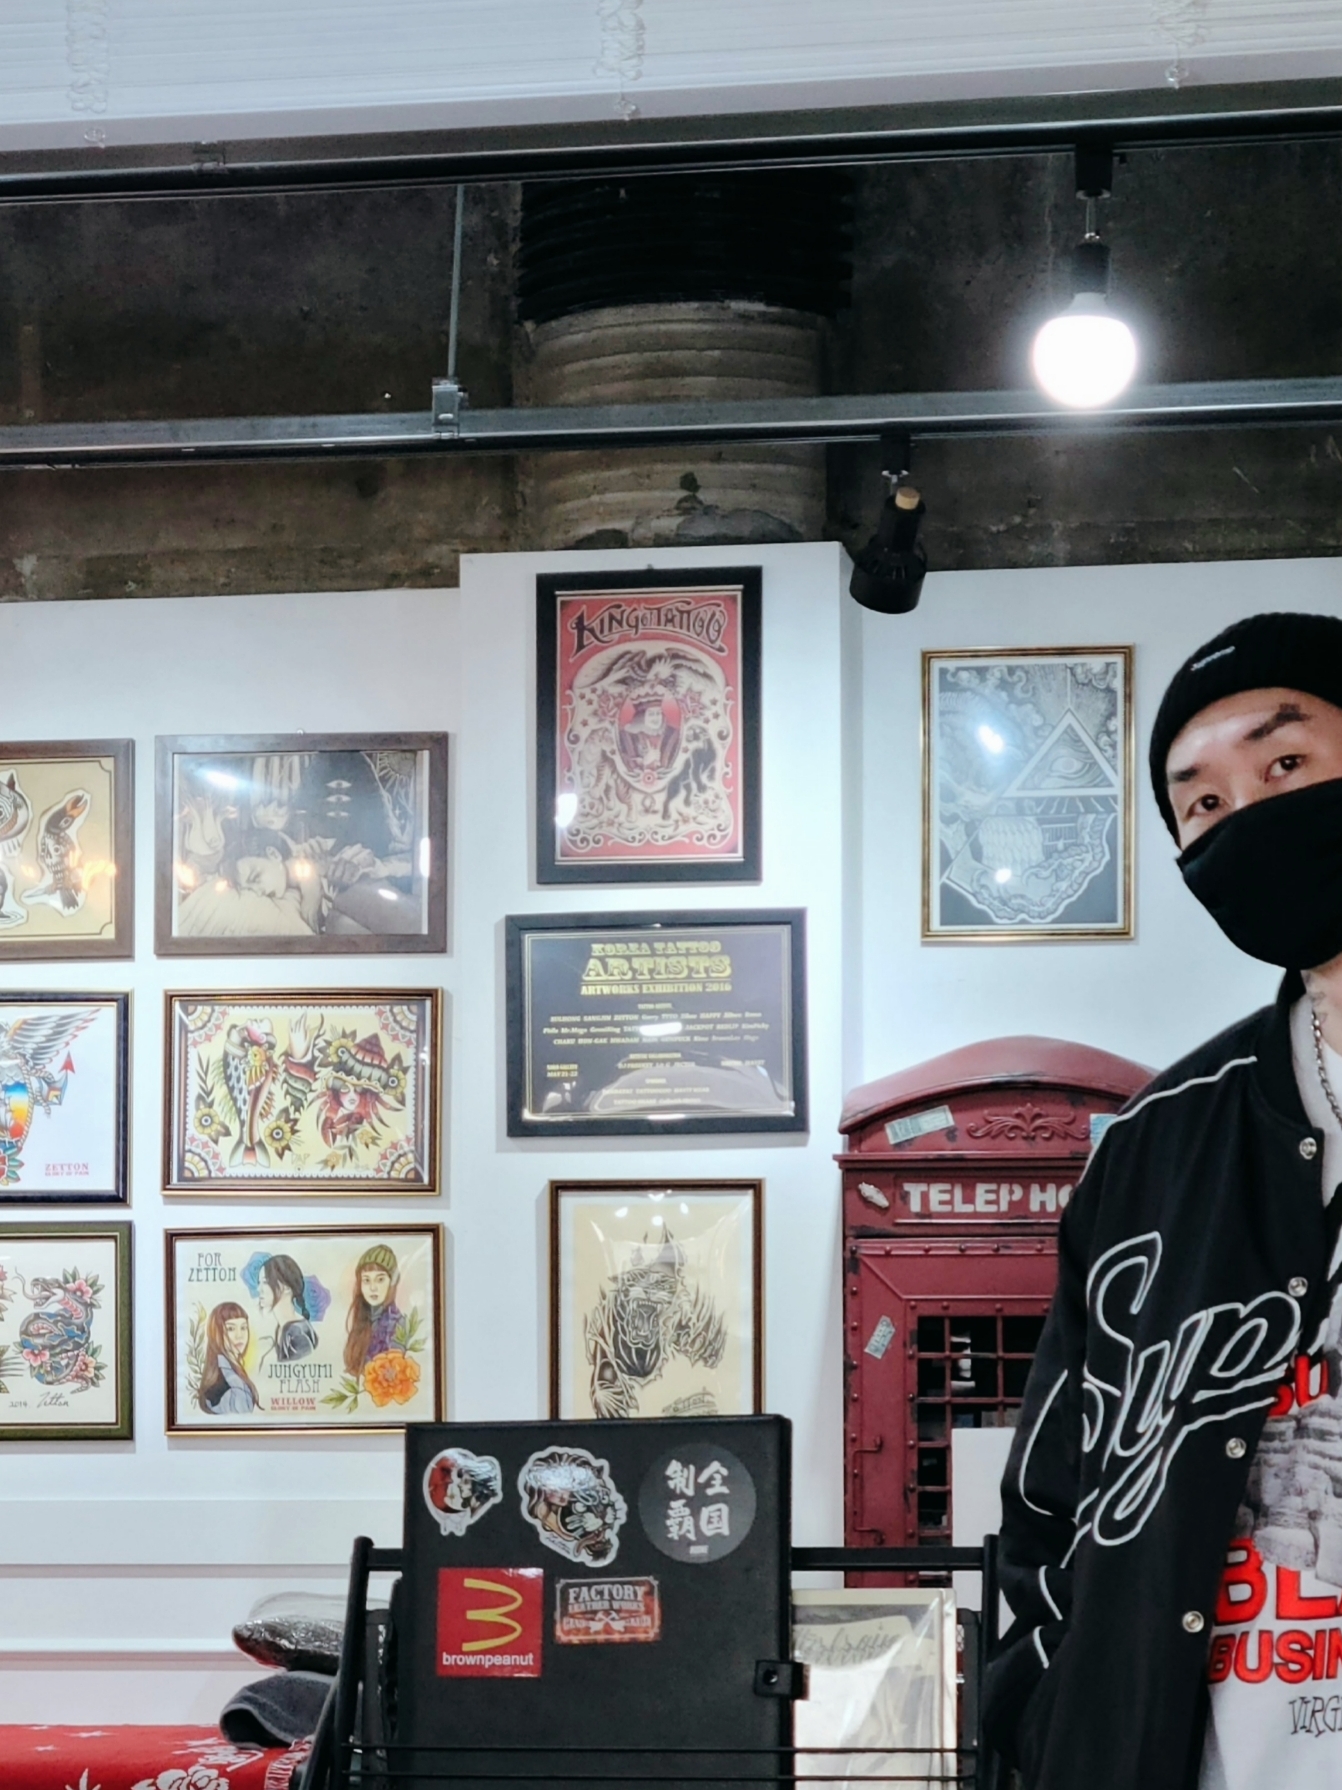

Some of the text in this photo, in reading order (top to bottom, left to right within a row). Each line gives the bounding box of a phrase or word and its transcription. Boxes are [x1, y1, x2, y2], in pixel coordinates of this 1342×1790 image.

[643, 599, 728, 648] TATTOO
[591, 940, 722, 957] KOREA TATTOO
[582, 955, 733, 981] ARTISTS
[580, 981, 733, 996] ARTWORKS EXHIBITION 2016
[45, 1163, 90, 1171] ZETTON
[197, 1252, 222, 1267] FOR
[188, 1267, 237, 1282] ZETTON
[268, 1363, 334, 1379] JUNGYUMI
[279, 1379, 321, 1393] FLASH
[270, 1397, 318, 1406] WILLOW
[568, 1584, 646, 1604] FACTORY
[612, 1601, 646, 1611] WORKS
[442, 1651, 534, 1669] brownpeanut
